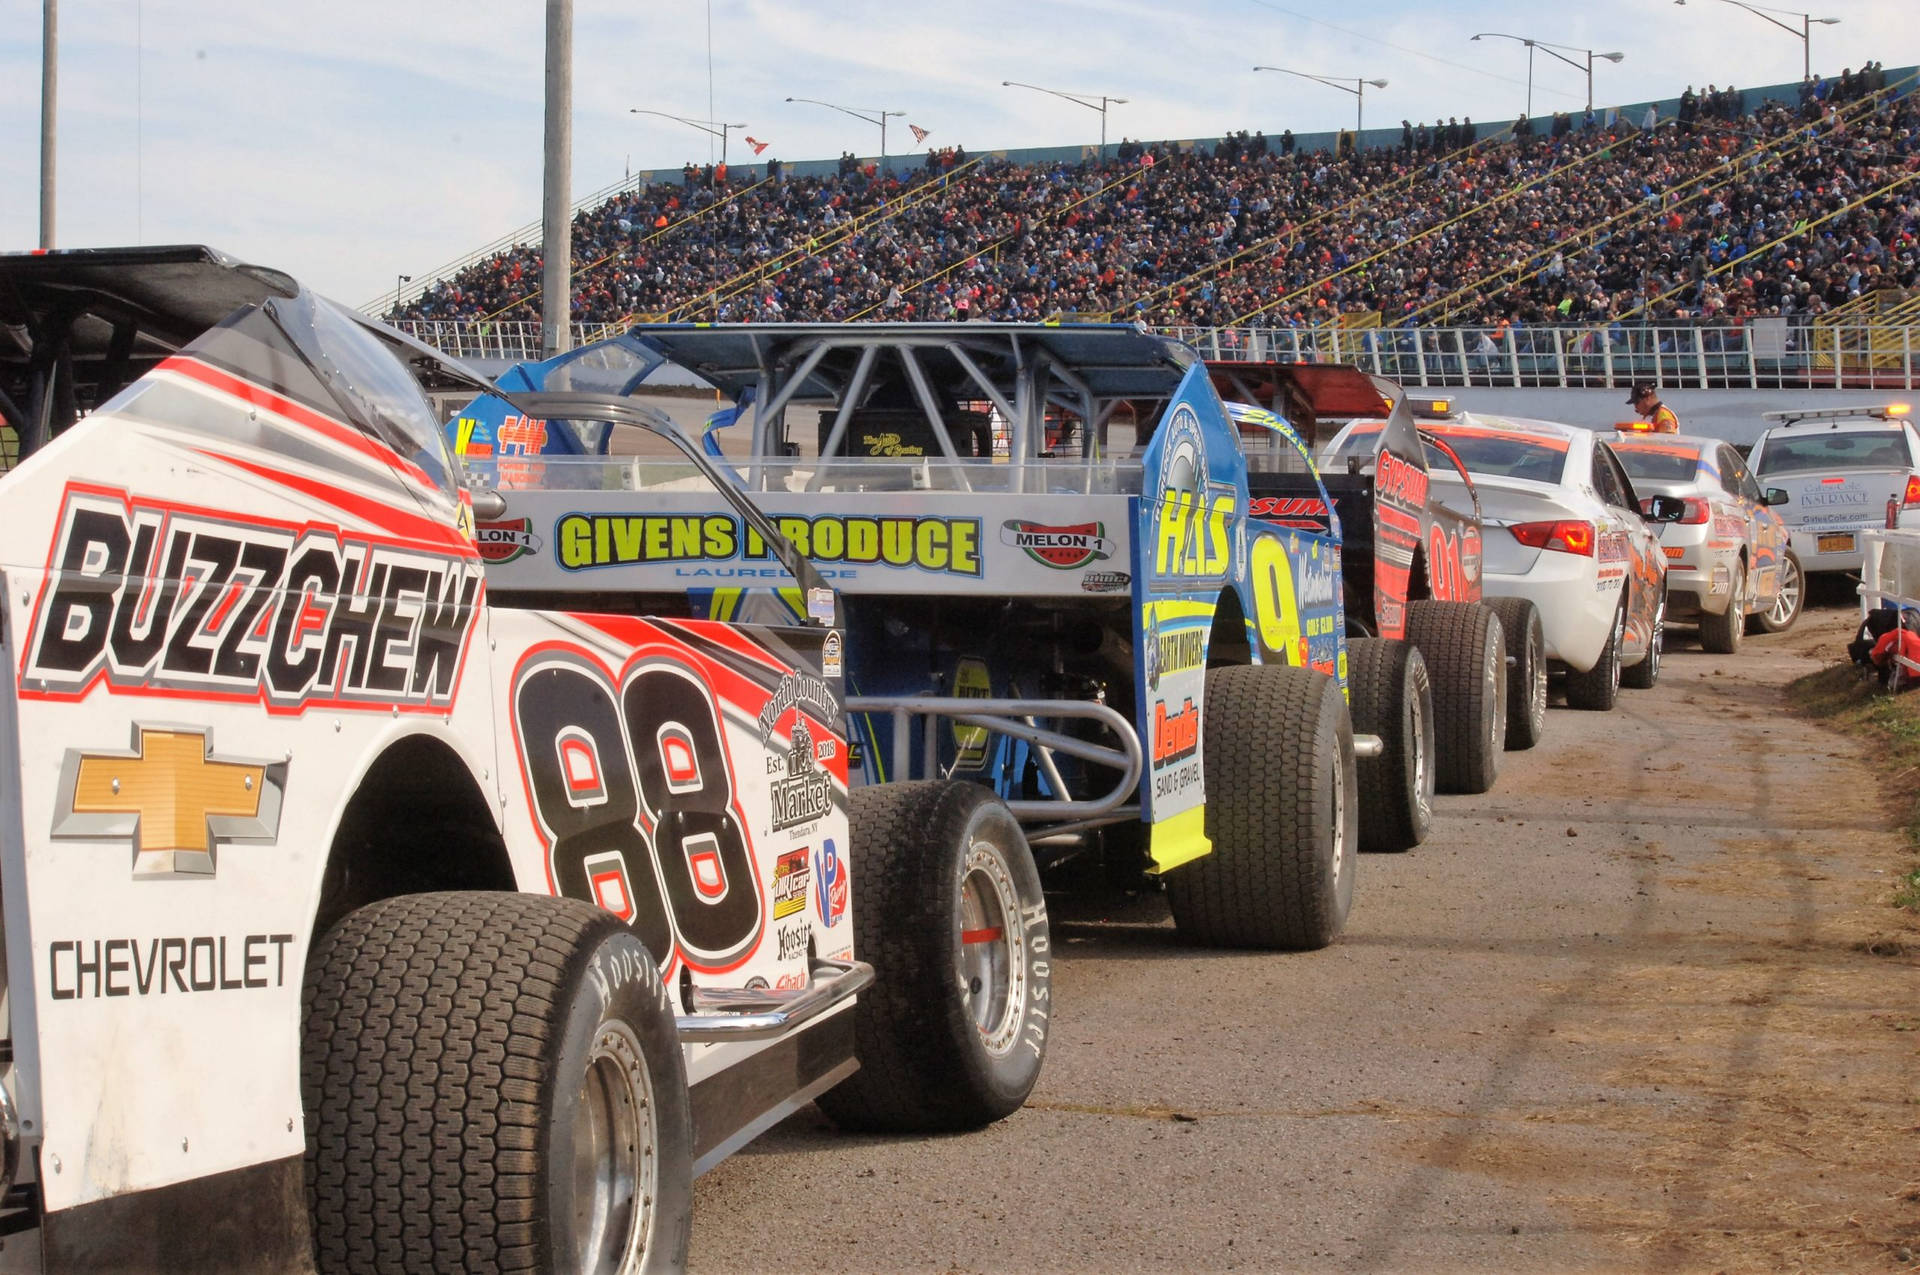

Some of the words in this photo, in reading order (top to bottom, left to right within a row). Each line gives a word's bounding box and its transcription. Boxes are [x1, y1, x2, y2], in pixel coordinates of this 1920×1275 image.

[1376, 449, 1429, 509] GYPSUM
[522, 534, 530, 545] 1
[556, 512, 738, 571] GIVENS
[1016, 533, 1087, 547] MELON
[1095, 539, 1103, 550] 1
[26, 495, 485, 704] BUZZCHEW
[1710, 582, 1729, 594] 200
[1160, 631, 1180, 675] EARTH
[1179, 628, 1204, 671] MOVERS
[758, 672, 794, 750] North
[793, 668, 839, 730] Country
[766, 756, 785, 774] Est.
[818, 741, 835, 759] 2018
[771, 771, 832, 832] Market
[1156, 774, 1173, 798] SAND
[1180, 762, 1200, 788] GRAVEL
[511, 643, 765, 978] 88
[814, 838, 837, 929] VP
[49, 934, 293, 1001] CHEVROLET
